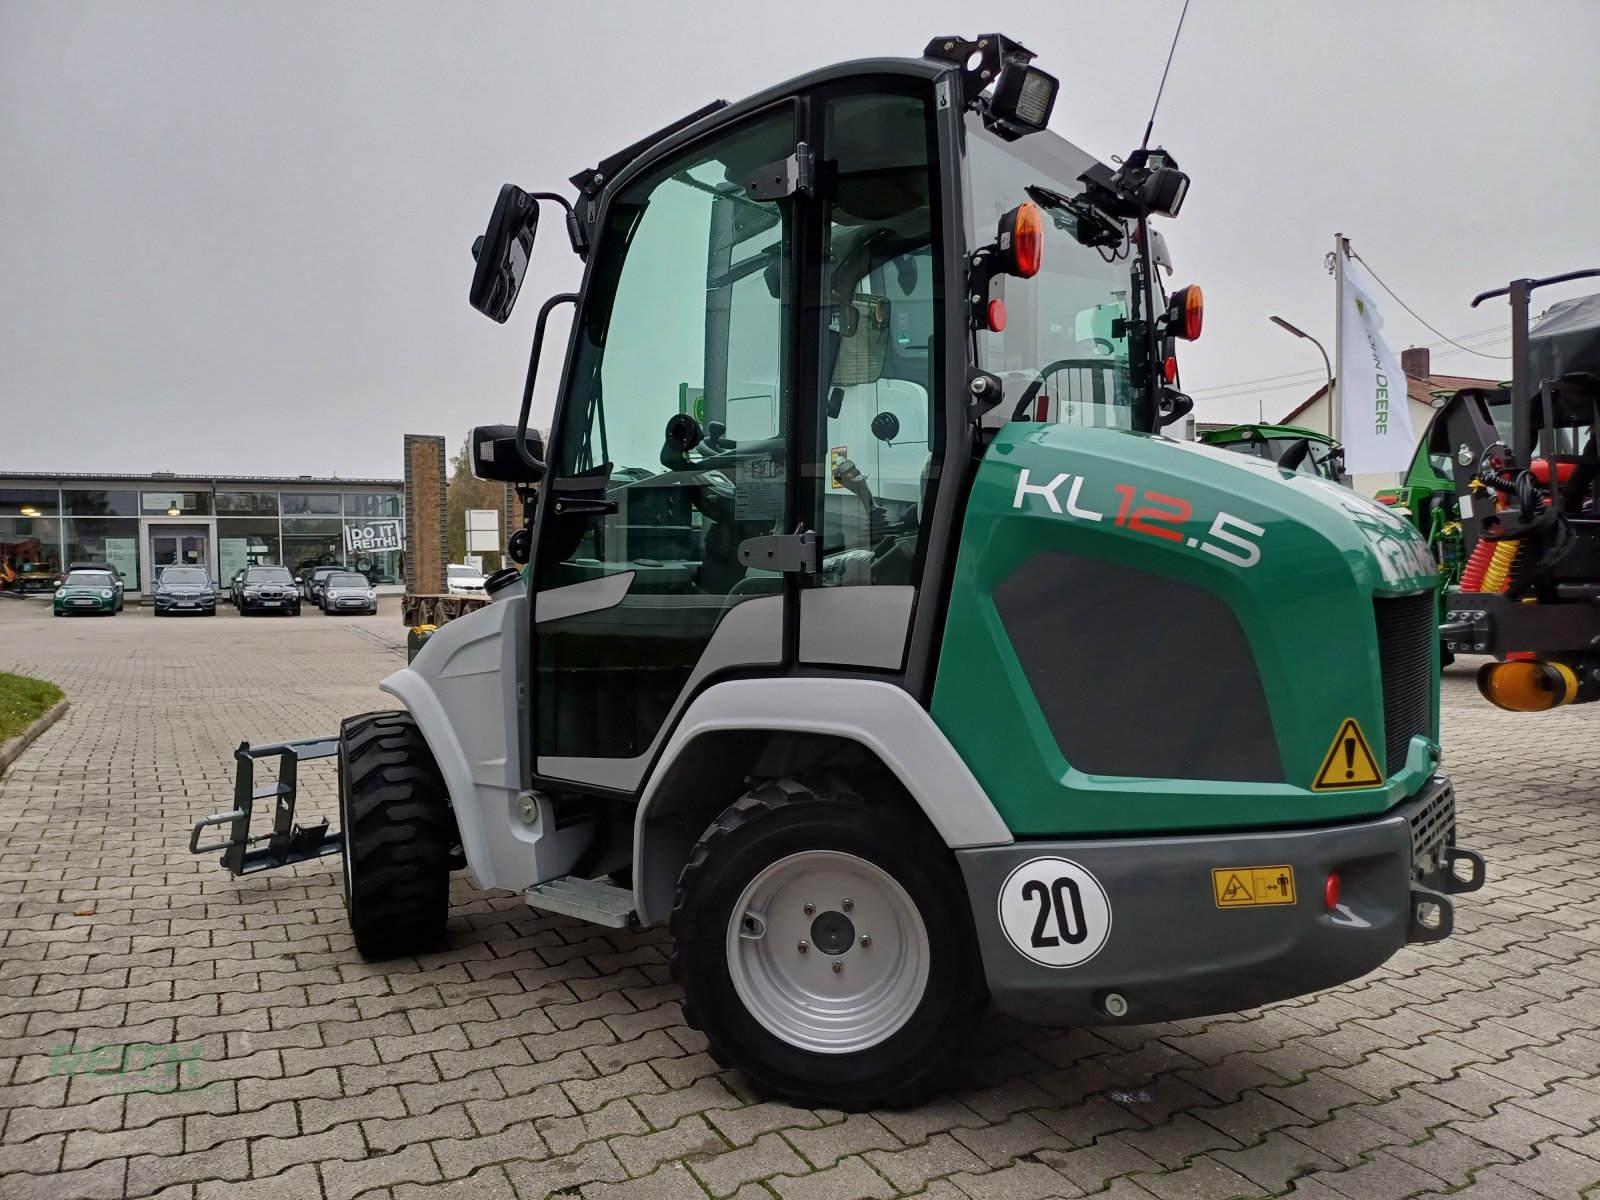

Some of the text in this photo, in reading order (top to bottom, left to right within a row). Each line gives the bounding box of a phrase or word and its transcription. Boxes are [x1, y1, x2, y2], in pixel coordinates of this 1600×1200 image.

[1375, 374, 1389, 436] DEERE
[351, 525, 394, 540] DO IT
[353, 536, 396, 550] REITH!
[1021, 876, 1088, 948] 20
